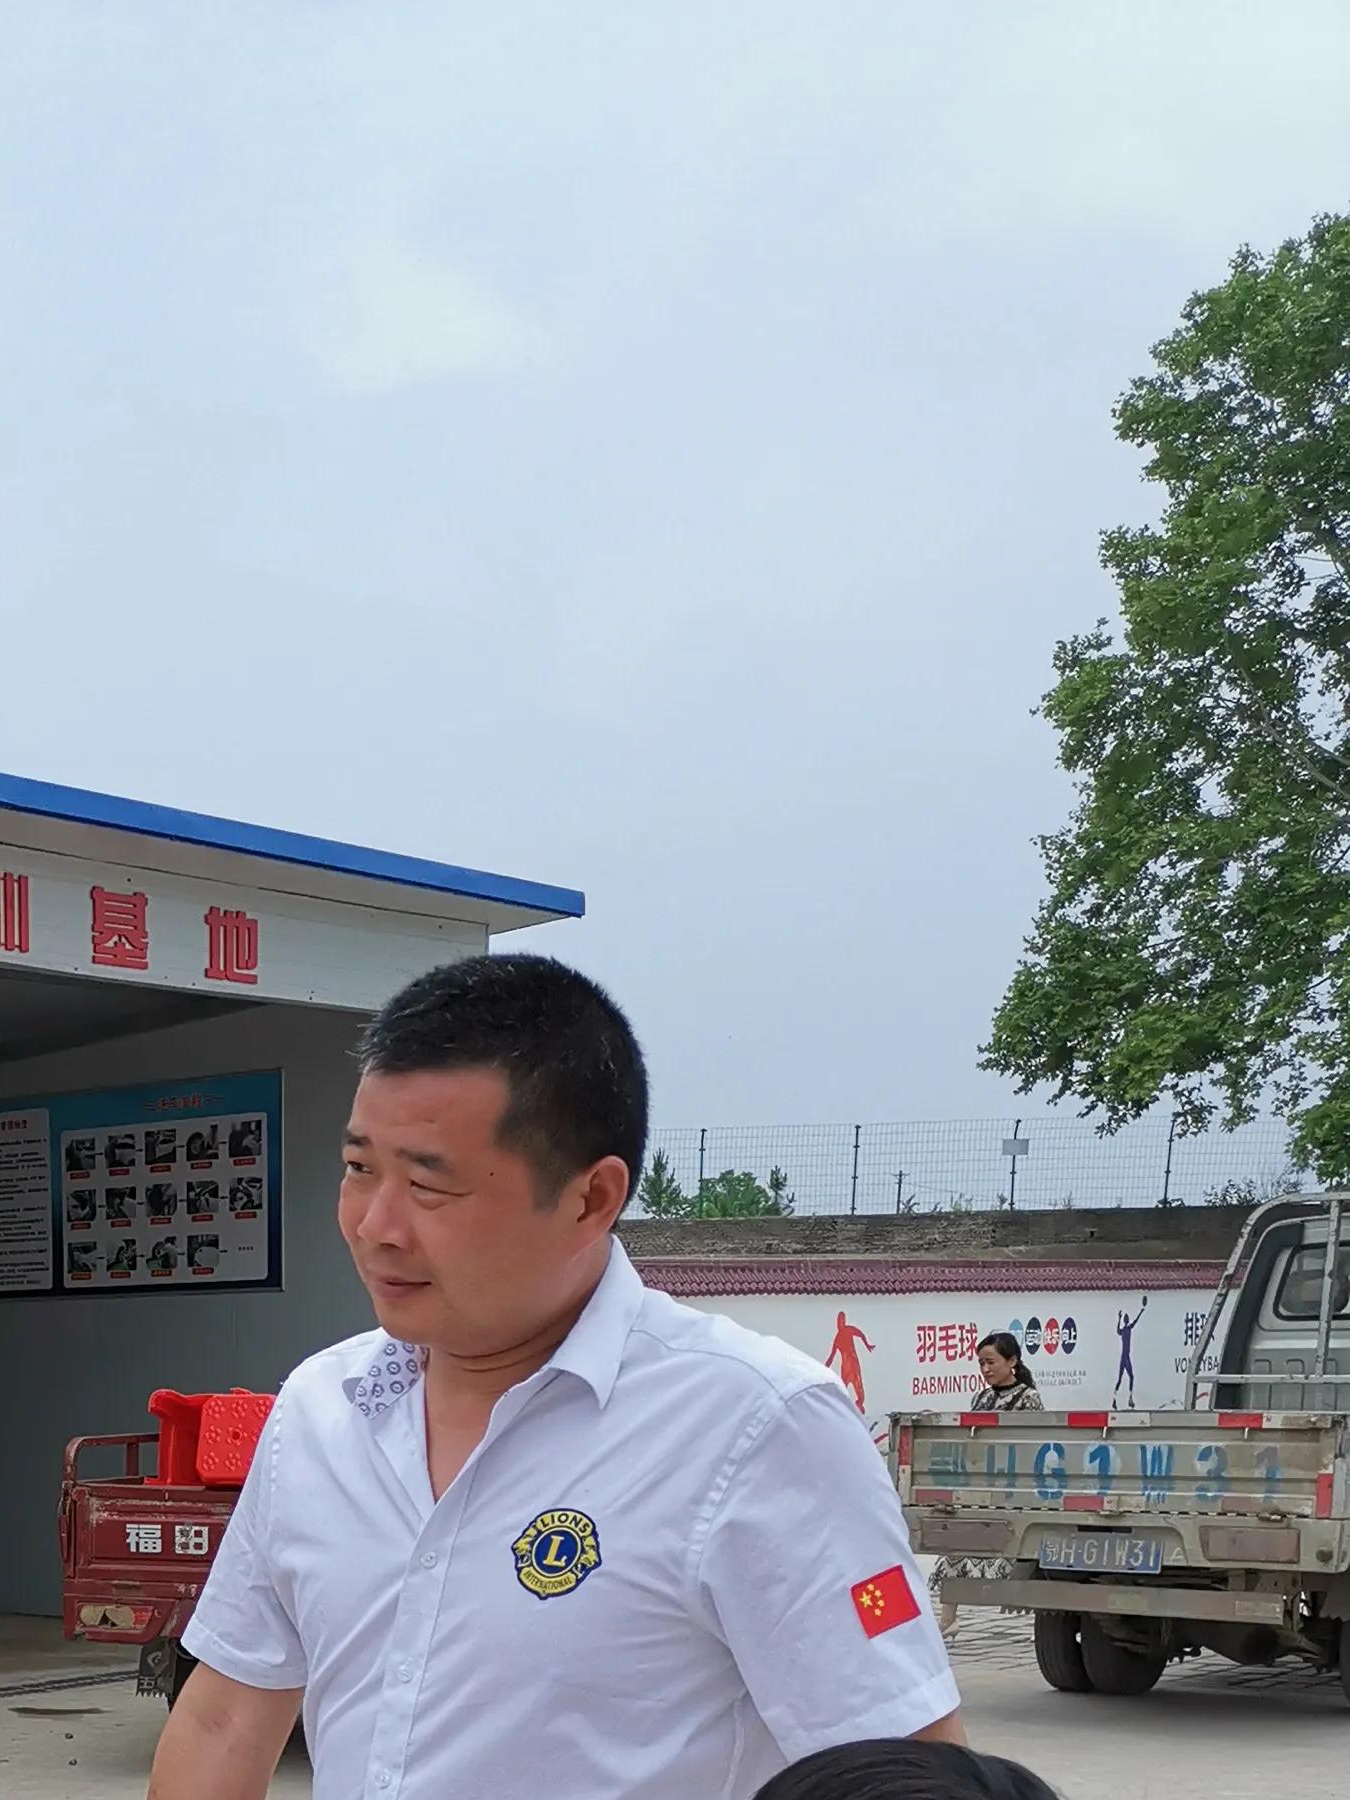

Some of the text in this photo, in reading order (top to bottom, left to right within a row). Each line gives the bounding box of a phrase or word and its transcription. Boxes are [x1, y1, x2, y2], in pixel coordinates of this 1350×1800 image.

[916, 1322, 979, 1363] 羽毛球
[539, 1512, 591, 1534] LIONS
[542, 1535, 568, 1567] L
